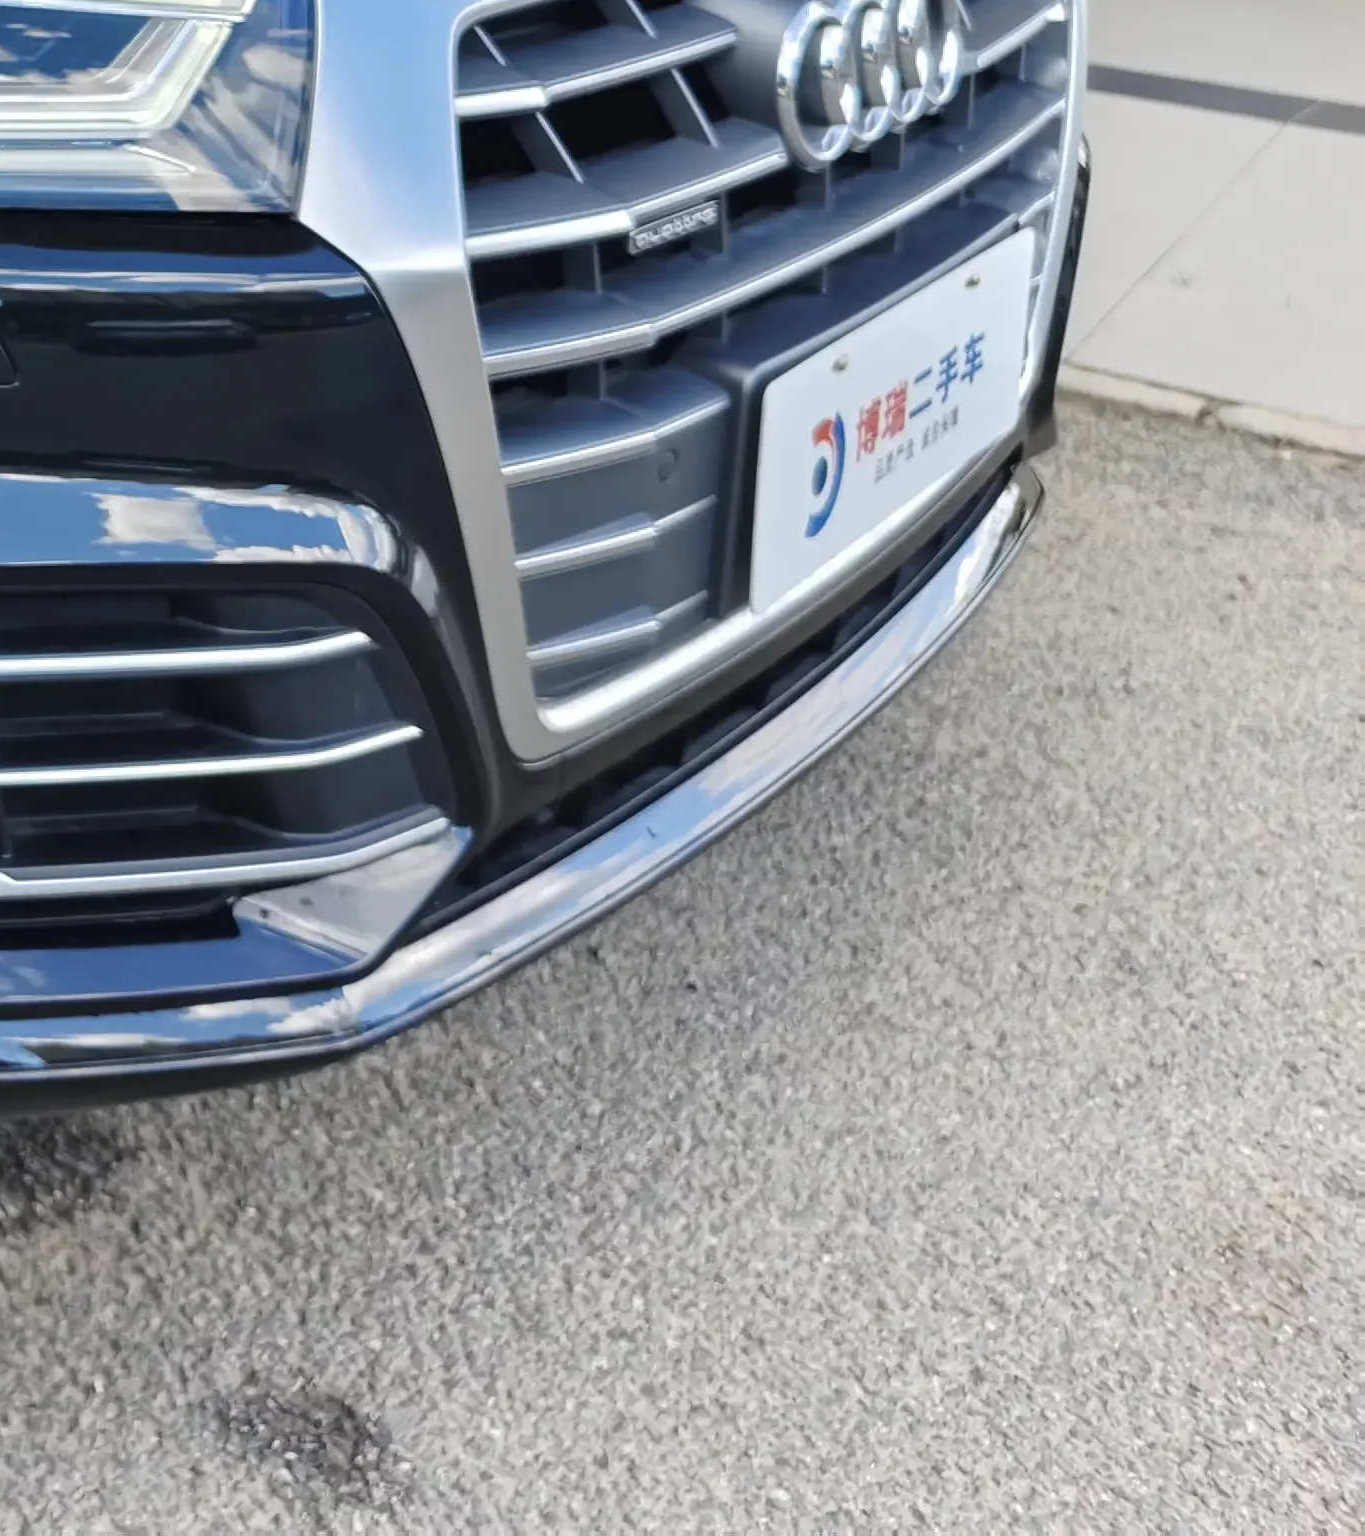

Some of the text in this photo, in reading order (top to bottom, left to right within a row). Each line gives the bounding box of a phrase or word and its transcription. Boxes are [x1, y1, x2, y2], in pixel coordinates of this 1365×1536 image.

[856, 331, 985, 463] 博瑞二手车
